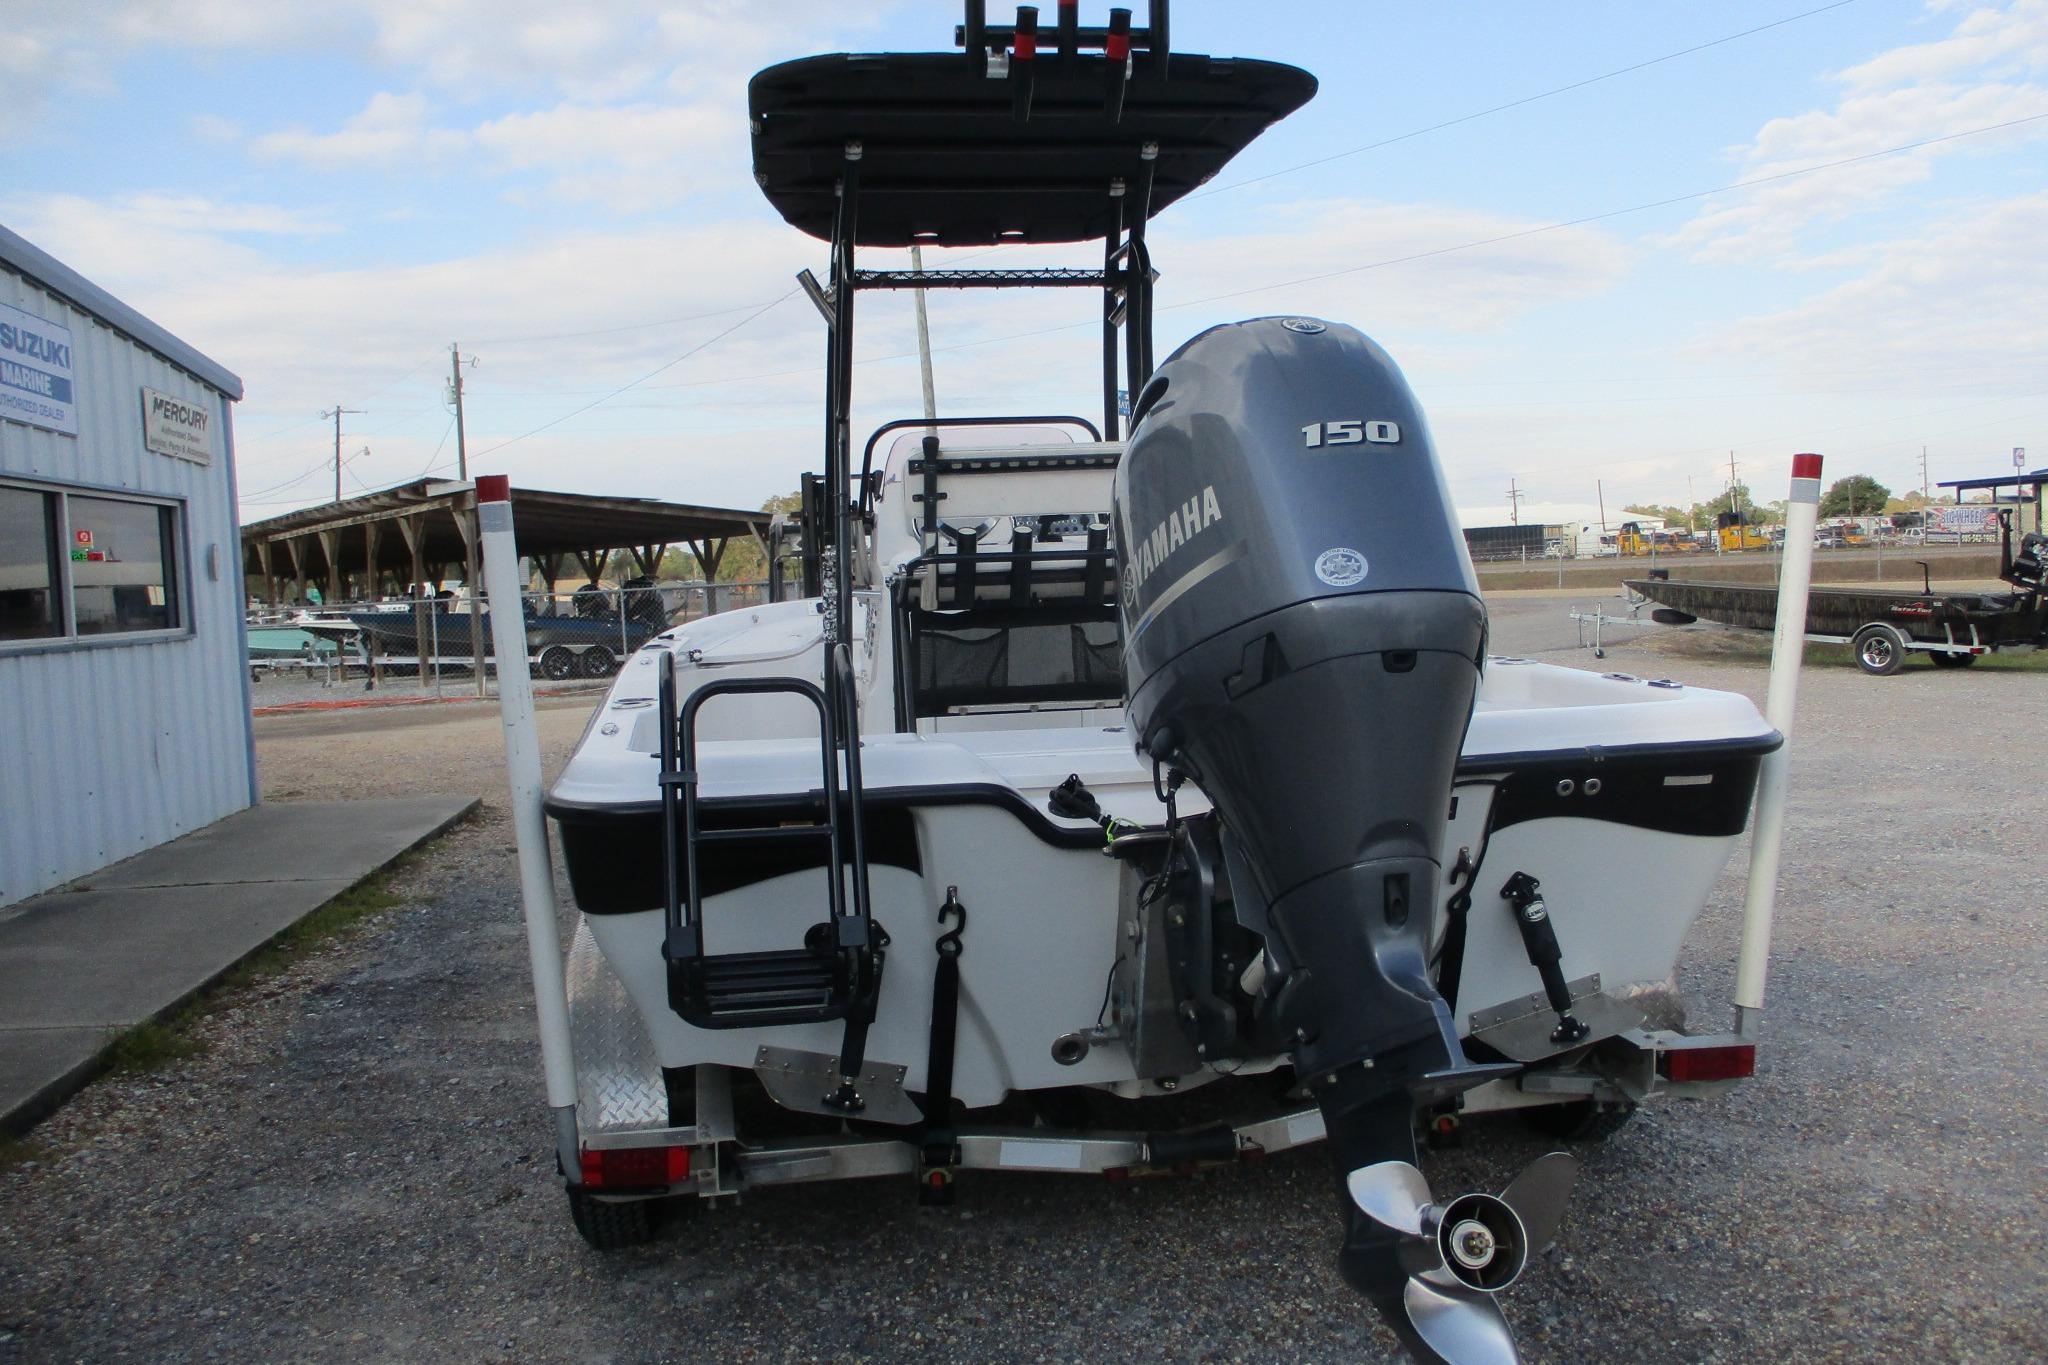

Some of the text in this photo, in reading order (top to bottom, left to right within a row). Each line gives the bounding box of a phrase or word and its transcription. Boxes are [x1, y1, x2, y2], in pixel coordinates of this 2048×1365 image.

[0, 322, 71, 369] SUZUKI
[1, 359, 53, 396] MARINE
[153, 396, 208, 431] MERCURY
[1301, 420, 1400, 447] 150
[1134, 485, 1222, 587] YAMAHA
